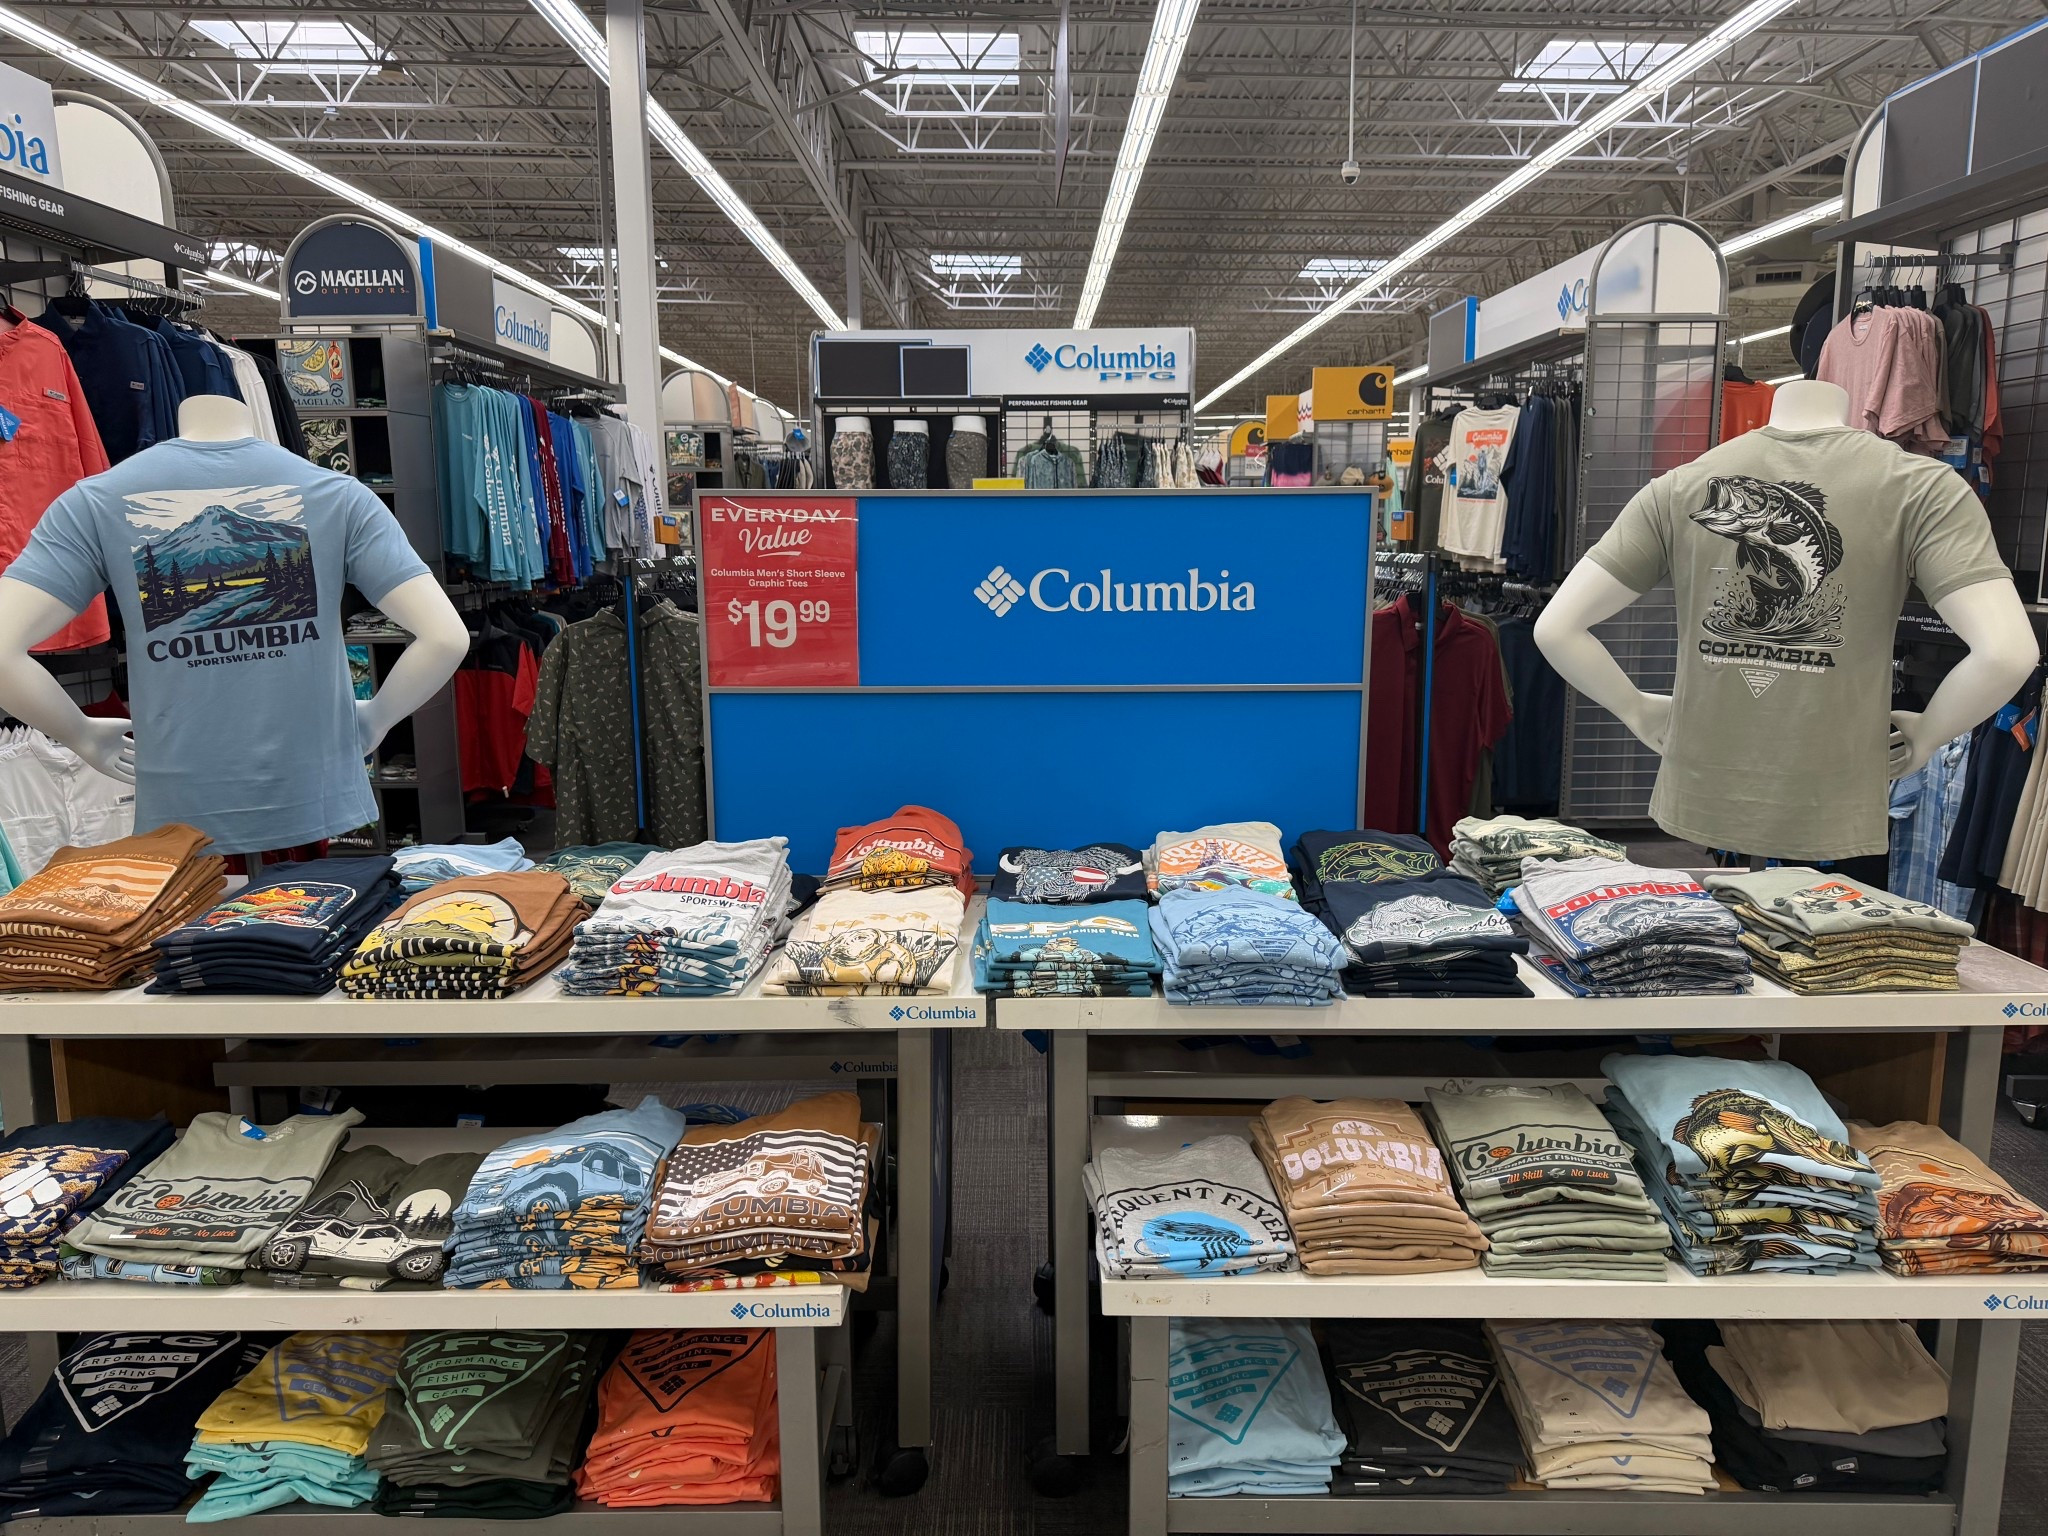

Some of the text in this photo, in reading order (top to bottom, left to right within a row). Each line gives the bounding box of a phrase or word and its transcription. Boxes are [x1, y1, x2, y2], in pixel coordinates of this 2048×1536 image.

[38, 198, 65, 217] GEAR
[321, 269, 404, 288] MAGELLAN
[321, 287, 405, 295] OUTDOORS
[495, 305, 550, 352] Columbia
[1055, 344, 1176, 369] Columbia
[1100, 372, 1176, 381] PFG
[711, 508, 841, 523] EVERYDAY
[738, 525, 812, 554] Value
[710, 568, 845, 578] Columbia Men's Short Sleeve
[748, 579, 808, 588] Graphic Tees
[1029, 567, 1255, 612] Columbia
[147, 620, 321, 662] COLUMBIA
[187, 649, 287, 668] SPORTSWEAR CO.
[1698, 639, 1836, 668] COLUMBIA
[1702, 654, 1826, 674] PERFORMANCE FISHING GEAR
[845, 838, 945, 862] Columbia
[158, 856, 180, 864] 1938
[611, 873, 767, 903] Columbia
[1545, 882, 1704, 918] COLUMBIA
[906, 1005, 977, 1020] Columbia
[844, 1061, 898, 1073] Columbia
[1282, 1138, 1443, 1181] COLUMBIA
[1463, 1133, 1625, 1171] Columbia
[1554, 1154, 1594, 1165] FISHING
[1596, 1160, 1622, 1168] GEAR
[1506, 1169, 1543, 1185] All Skill
[1570, 1168, 1610, 1179] No Luck
[126, 1184, 303, 1211] Columbia
[200, 1213, 241, 1223] FISHING
[669, 1216, 827, 1236] SPORTSWEAR CO.
[1220, 1192, 1291, 1243] FLYER
[146, 1226, 169, 1237] Skill
[194, 1228, 237, 1238] No Luck
[750, 1303, 831, 1319] Columbia
[404, 1336, 546, 1369] PFG
[658, 1348, 712, 1368] FISHING
[94, 1369, 156, 1381] FISHING
[1171, 1358, 1273, 1385] ERFORMANCE
[1348, 1356, 1489, 1378] PFG
[427, 1372, 486, 1384] FISHING
[1192, 1372, 1250, 1394] FISHING
[1369, 1374, 1477, 1388] PERFORMANCE
[98, 1383, 139, 1392] GEAR
[302, 1383, 337, 1398] GEAR
[432, 1387, 470, 1399] GEAR
[1205, 1386, 1243, 1402] GEAR
[1399, 1388, 1457, 1396] FISHING
